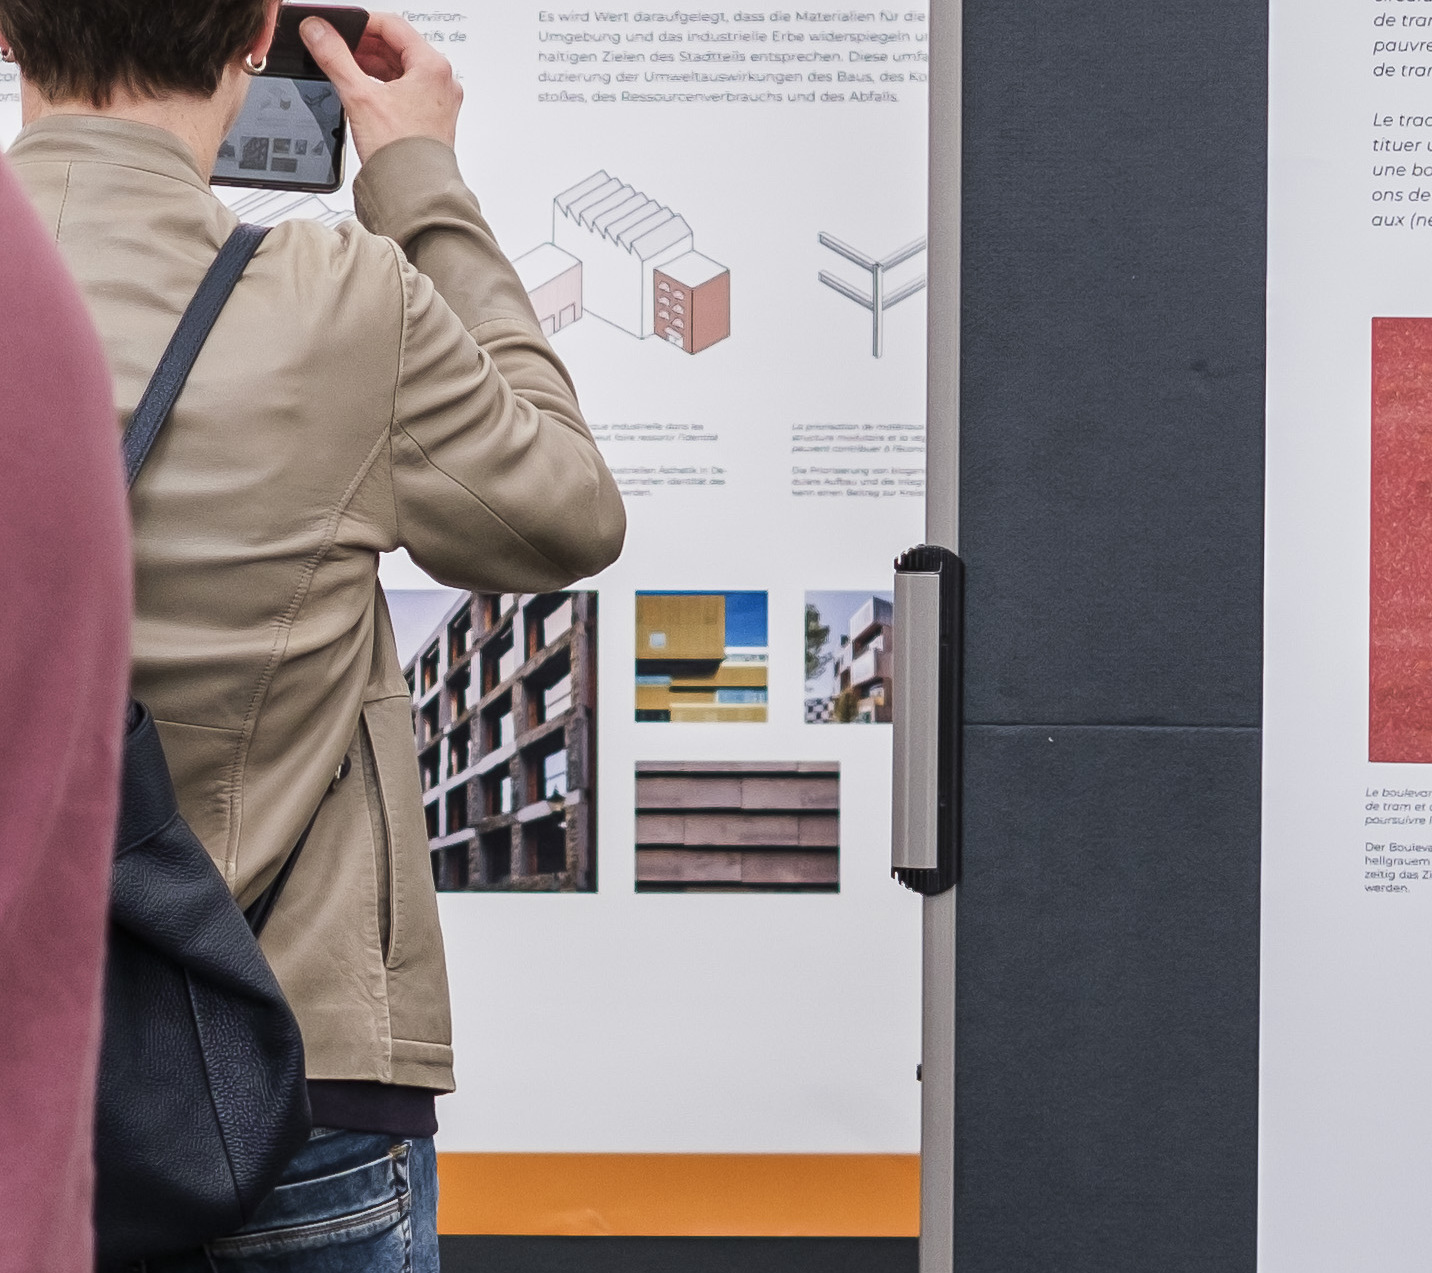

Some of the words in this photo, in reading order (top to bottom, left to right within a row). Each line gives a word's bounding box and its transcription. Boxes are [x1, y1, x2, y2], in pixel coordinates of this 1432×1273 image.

[1373, 11, 1397, 28] de
[1372, 61, 1396, 78] de
[1372, 112, 1394, 128] Le
[1371, 215, 1406, 227] aux
